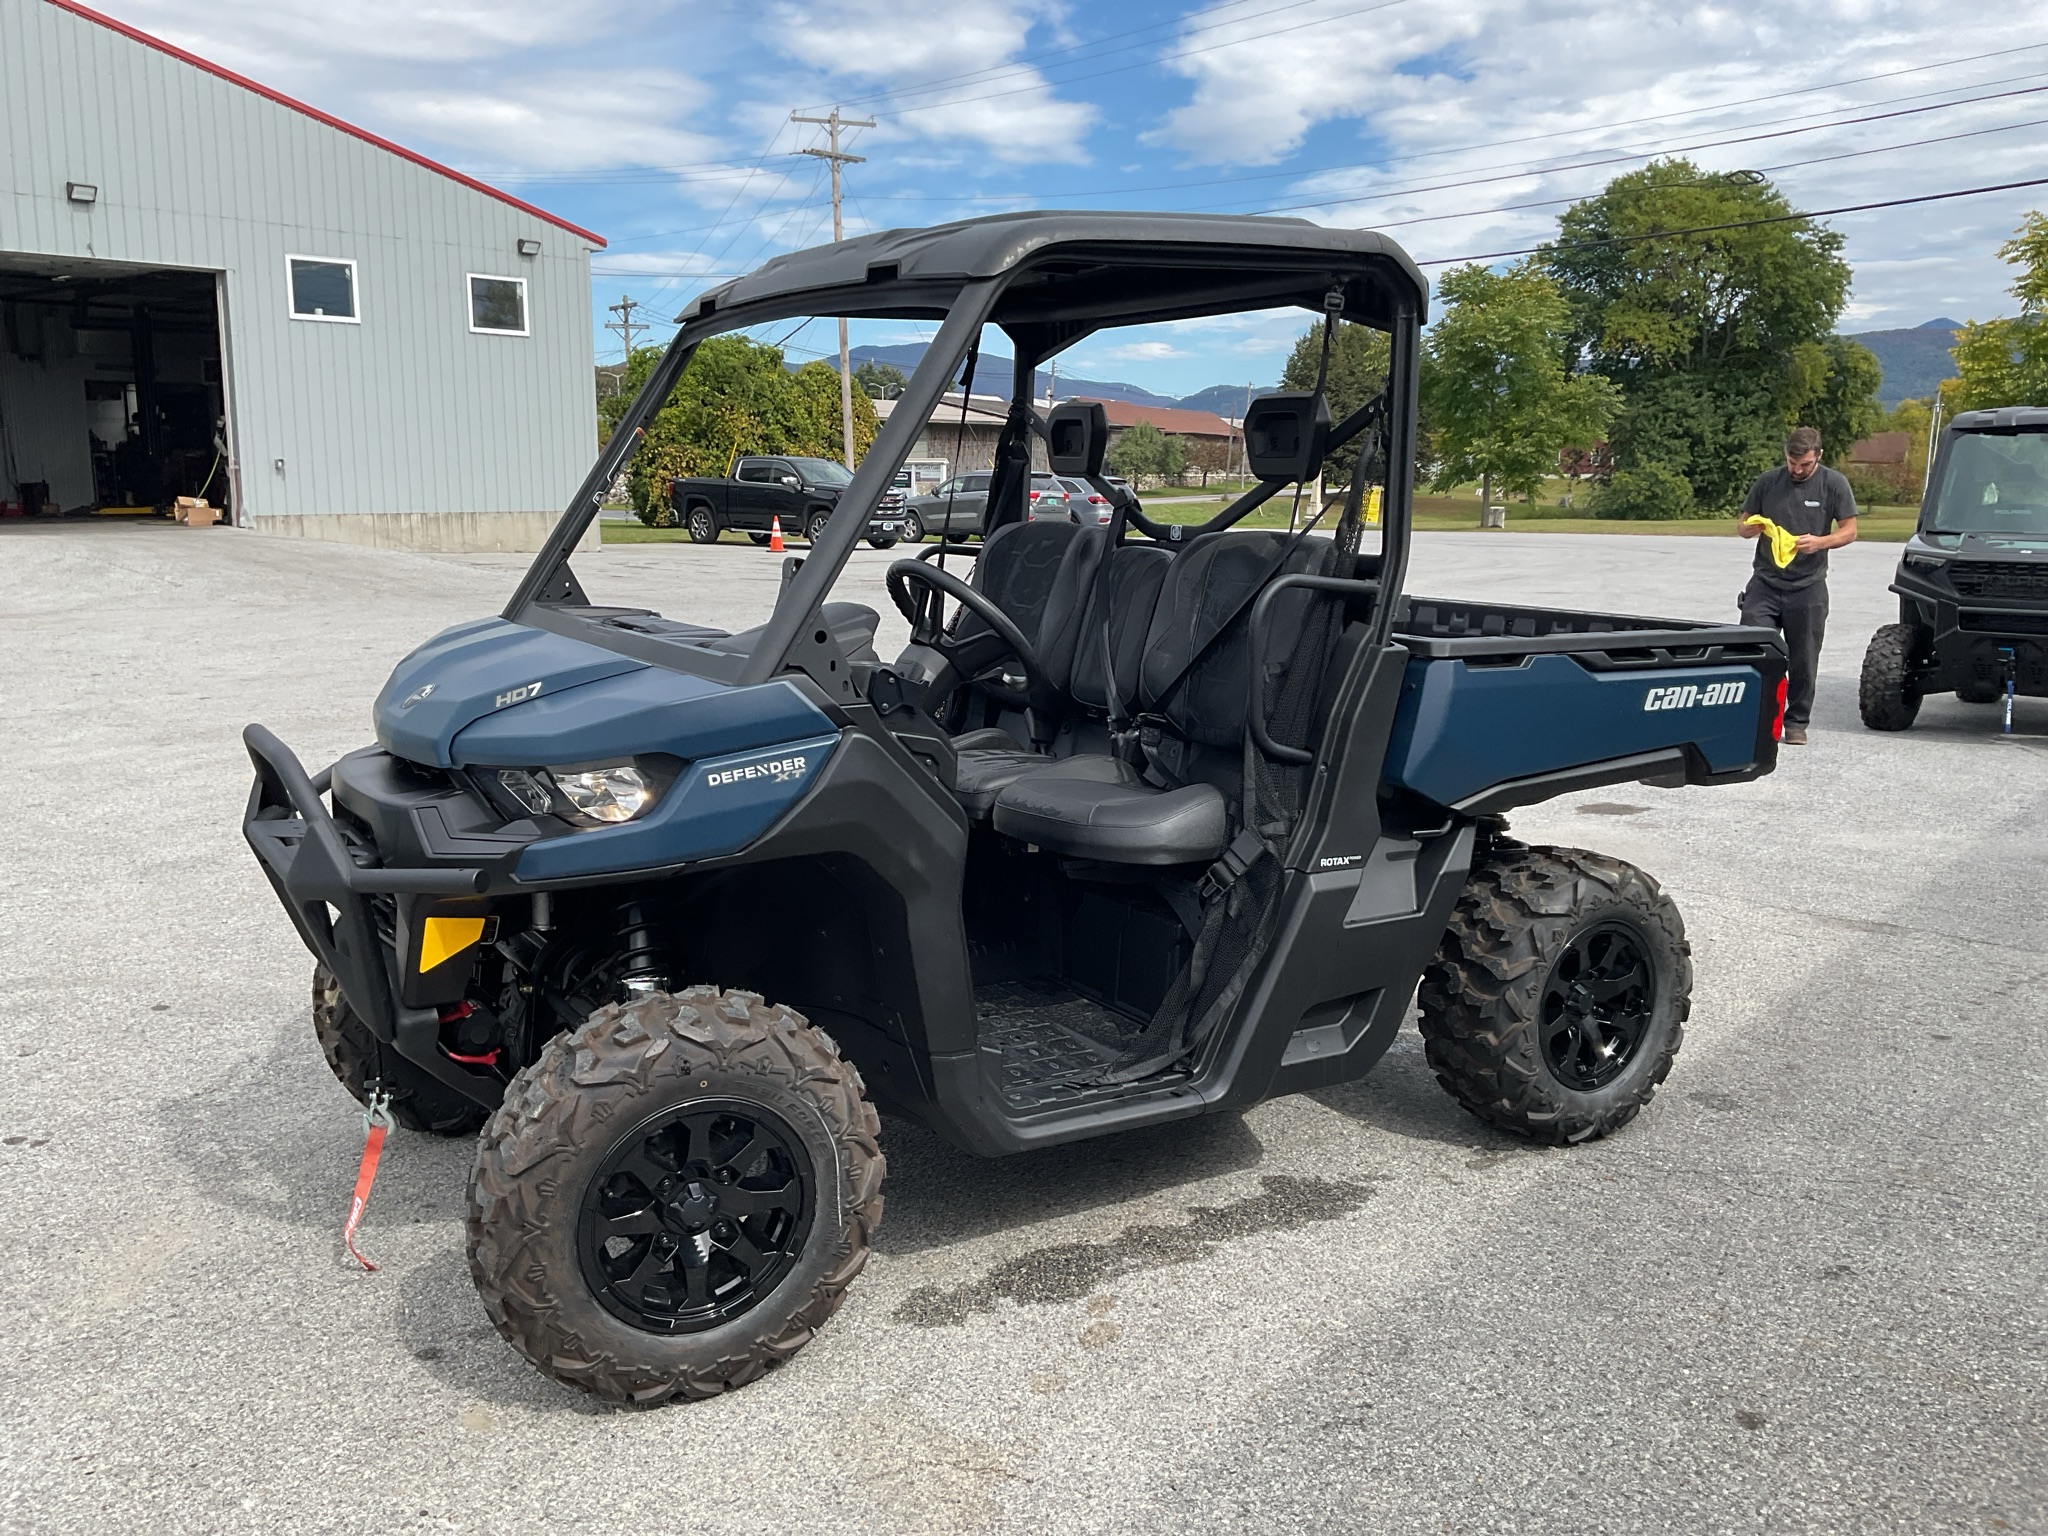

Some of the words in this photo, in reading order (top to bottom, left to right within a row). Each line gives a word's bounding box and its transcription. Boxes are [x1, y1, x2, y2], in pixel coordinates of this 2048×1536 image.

[495, 681, 542, 708] HD7
[1644, 681, 1746, 711] can-am
[707, 756, 806, 786] DEFENDER
[774, 768, 806, 783] XT
[1320, 855, 1350, 868] ROTAX
